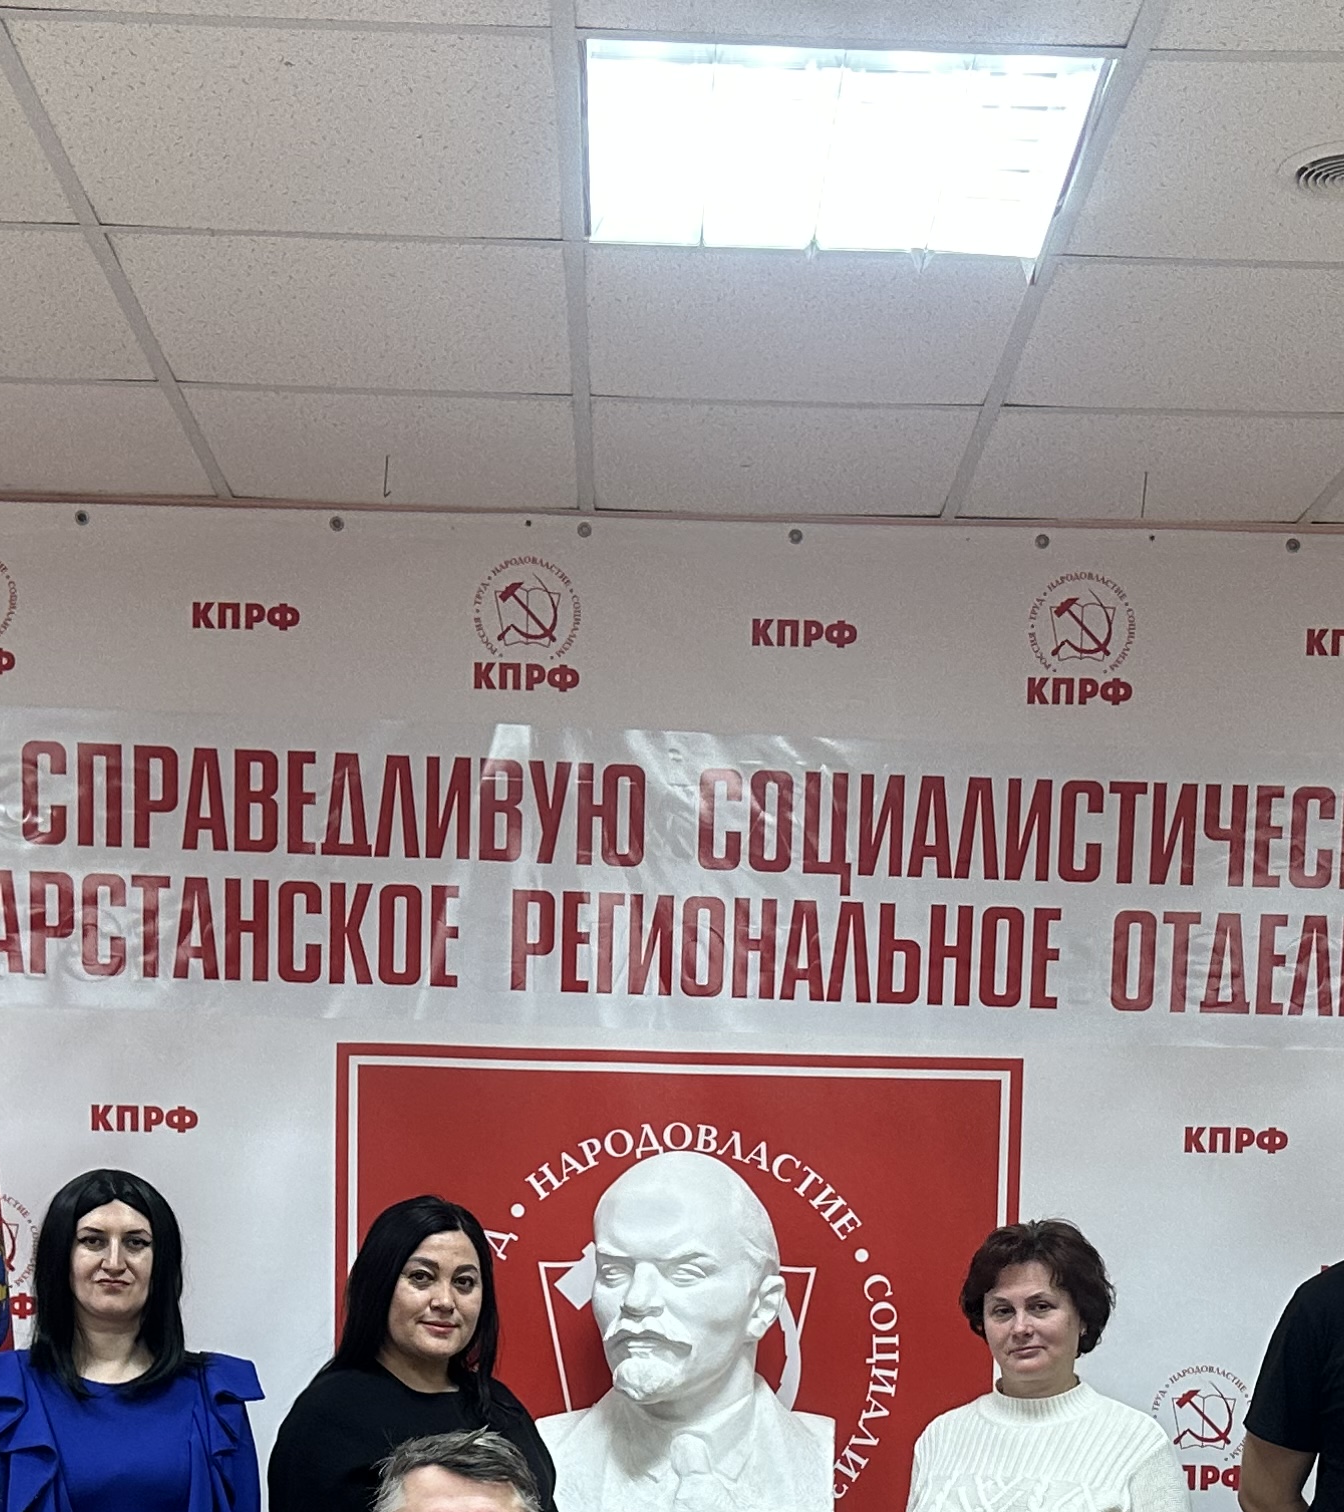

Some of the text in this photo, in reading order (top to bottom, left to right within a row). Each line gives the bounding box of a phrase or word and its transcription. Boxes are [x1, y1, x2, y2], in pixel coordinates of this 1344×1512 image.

[192, 602, 300, 631] КПРФ
[752, 619, 857, 647] КПРФ
[474, 662, 579, 691] КПРФ
[1027, 677, 1132, 705] КПРФ
[21, 741, 645, 868] СПРАВЕДЛИВУЮ
[511, 889, 1061, 1009] РЕГИОНАЛЬНОЕ
[91, 1104, 198, 1132] КПРФ
[1184, 1126, 1288, 1153] КПРФ
[524, 1120, 862, 1240] НАРОДОВЛАСТИЕ
[1182, 1464, 1242, 1491] ПРФ
